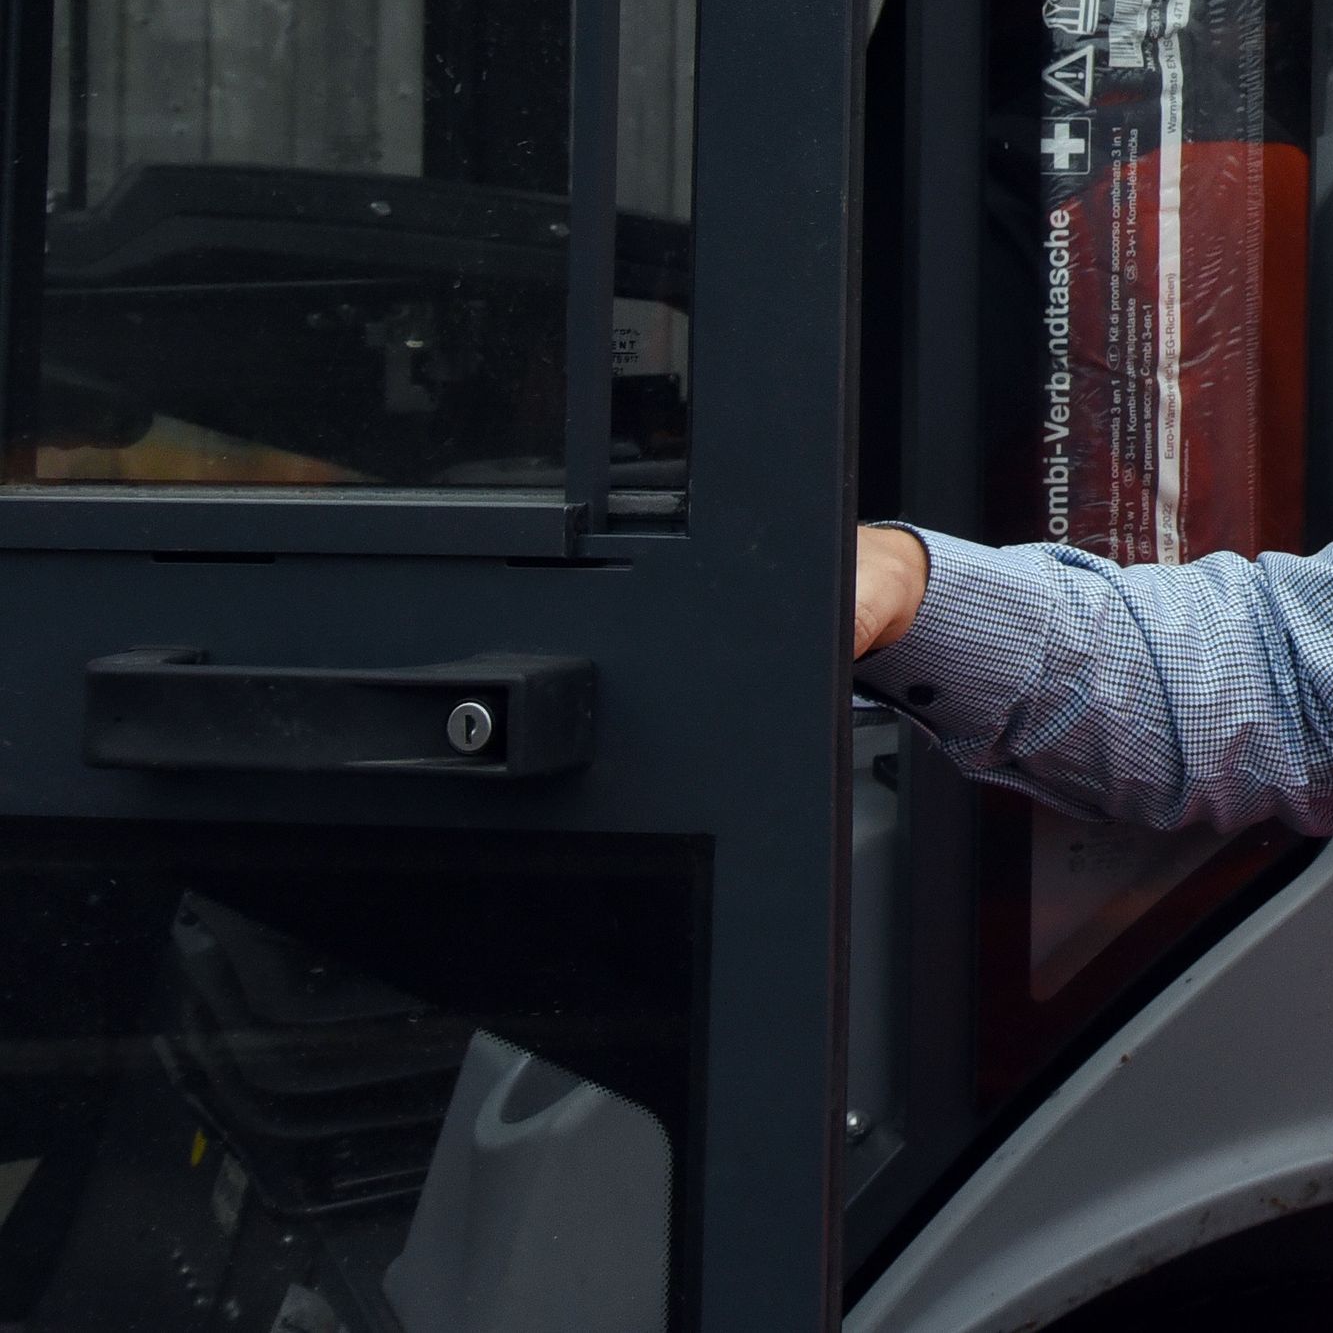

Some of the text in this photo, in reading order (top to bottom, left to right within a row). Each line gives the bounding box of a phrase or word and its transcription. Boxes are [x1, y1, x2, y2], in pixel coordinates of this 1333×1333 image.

[1165, 54, 1176, 70] EN
[1111, 136, 1122, 147] in
[1110, 159, 1121, 219] combinato
[1111, 221, 1121, 273] soccorso
[1126, 229, 1137, 258] 3-v-1
[1110, 274, 1122, 311] pronto
[1109, 313, 1119, 324] di
[1109, 326, 1119, 342] Kit
[1141, 304, 1153, 340] 3-en-1
[1164, 272, 1177, 360] (EG-Richtlinien)
[1043, 209, 1070, 544] ombi-Verbandtasche
[1112, 389, 1121, 404] en
[1109, 417, 1121, 479] combinada
[1142, 422, 1153, 471] premiers
[1140, 489, 1150, 533] Trousse
